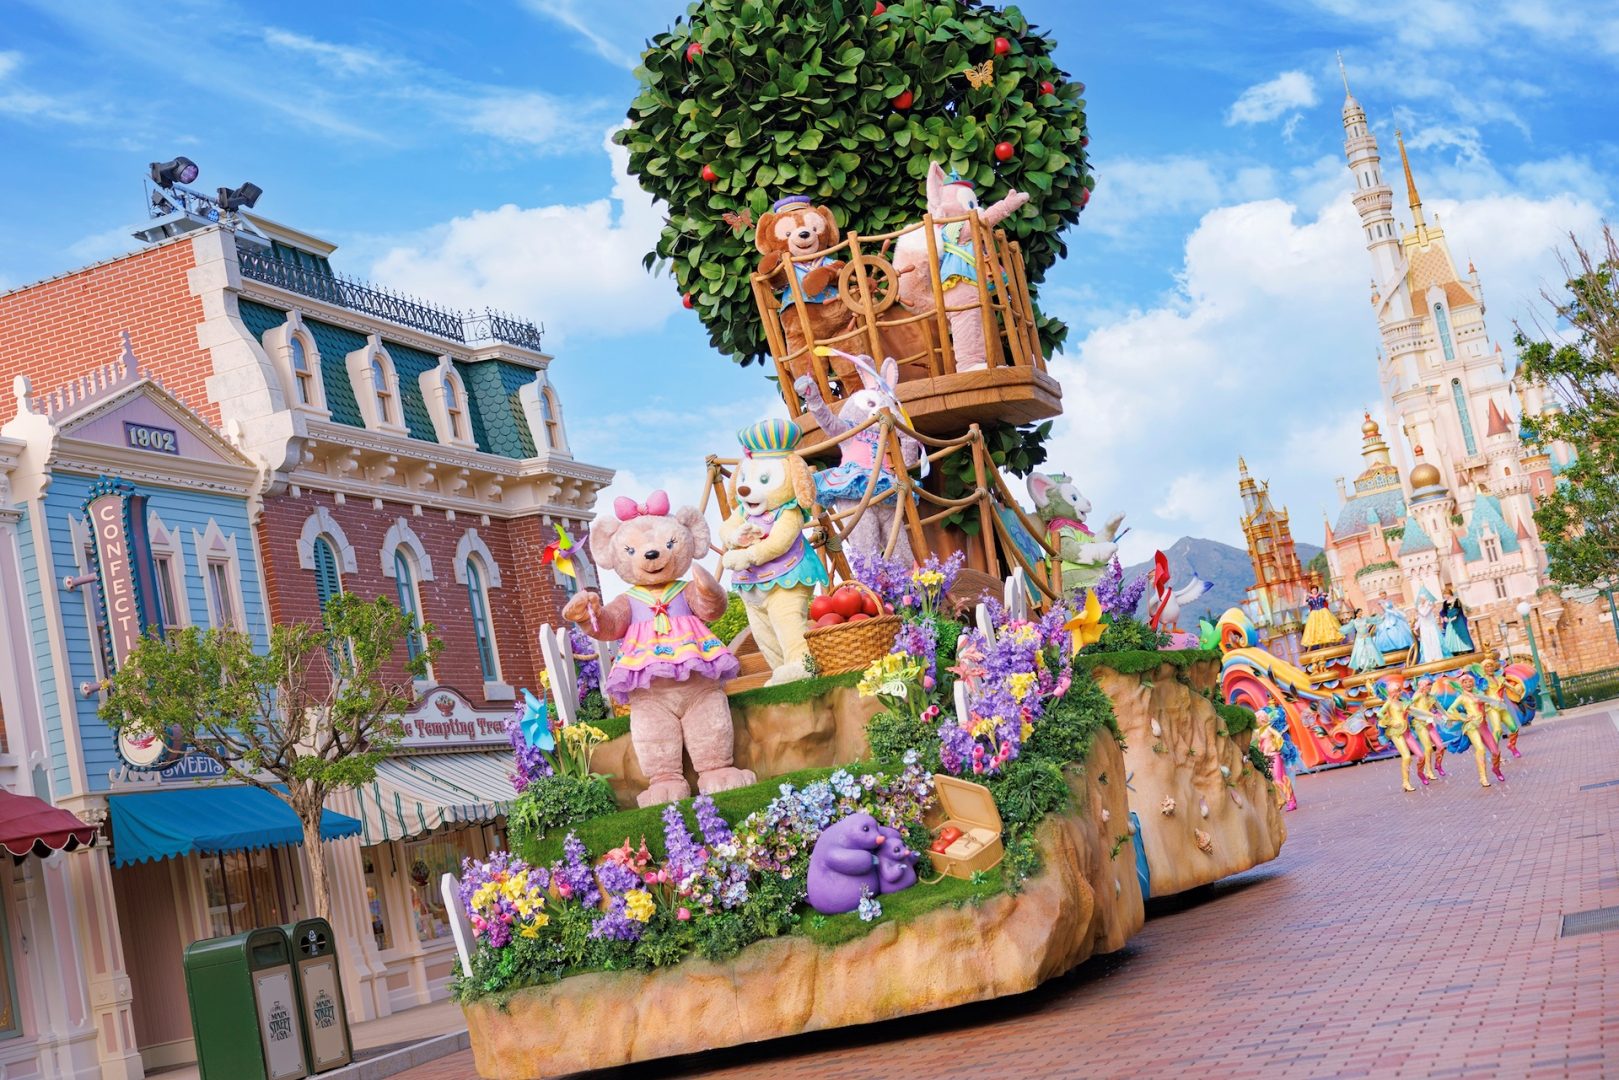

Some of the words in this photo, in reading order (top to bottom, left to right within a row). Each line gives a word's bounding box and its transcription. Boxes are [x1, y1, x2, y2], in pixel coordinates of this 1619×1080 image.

[129, 427, 176, 451] 1902
[414, 718, 476, 740] Tempting
[316, 1000, 331, 1009] MAIN
[271, 1011, 287, 1020] MAIN
[313, 1005, 335, 1026] STREET
[269, 1018, 291, 1039] STREET
[276, 1030, 288, 1041] USA
